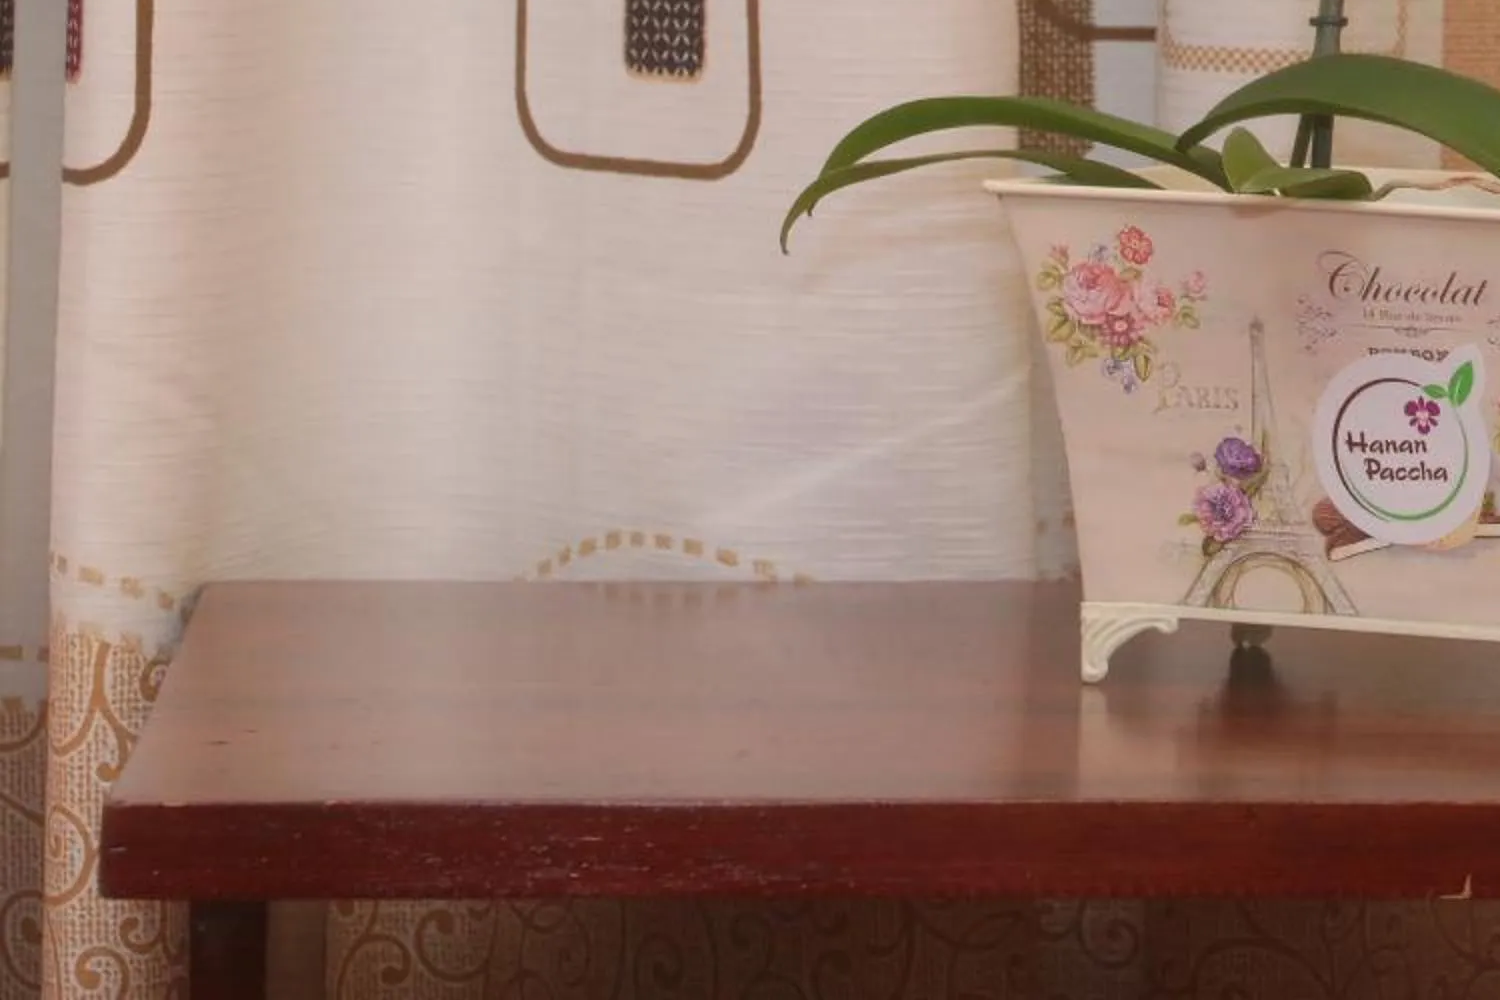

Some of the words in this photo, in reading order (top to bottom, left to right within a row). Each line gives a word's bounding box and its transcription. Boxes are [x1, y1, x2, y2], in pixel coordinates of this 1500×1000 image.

[1315, 250, 1488, 306] Chocolat
[1154, 361, 1240, 414] PARIS
[1345, 431, 1428, 455] Hanan
[1363, 457, 1449, 483] Paccha
